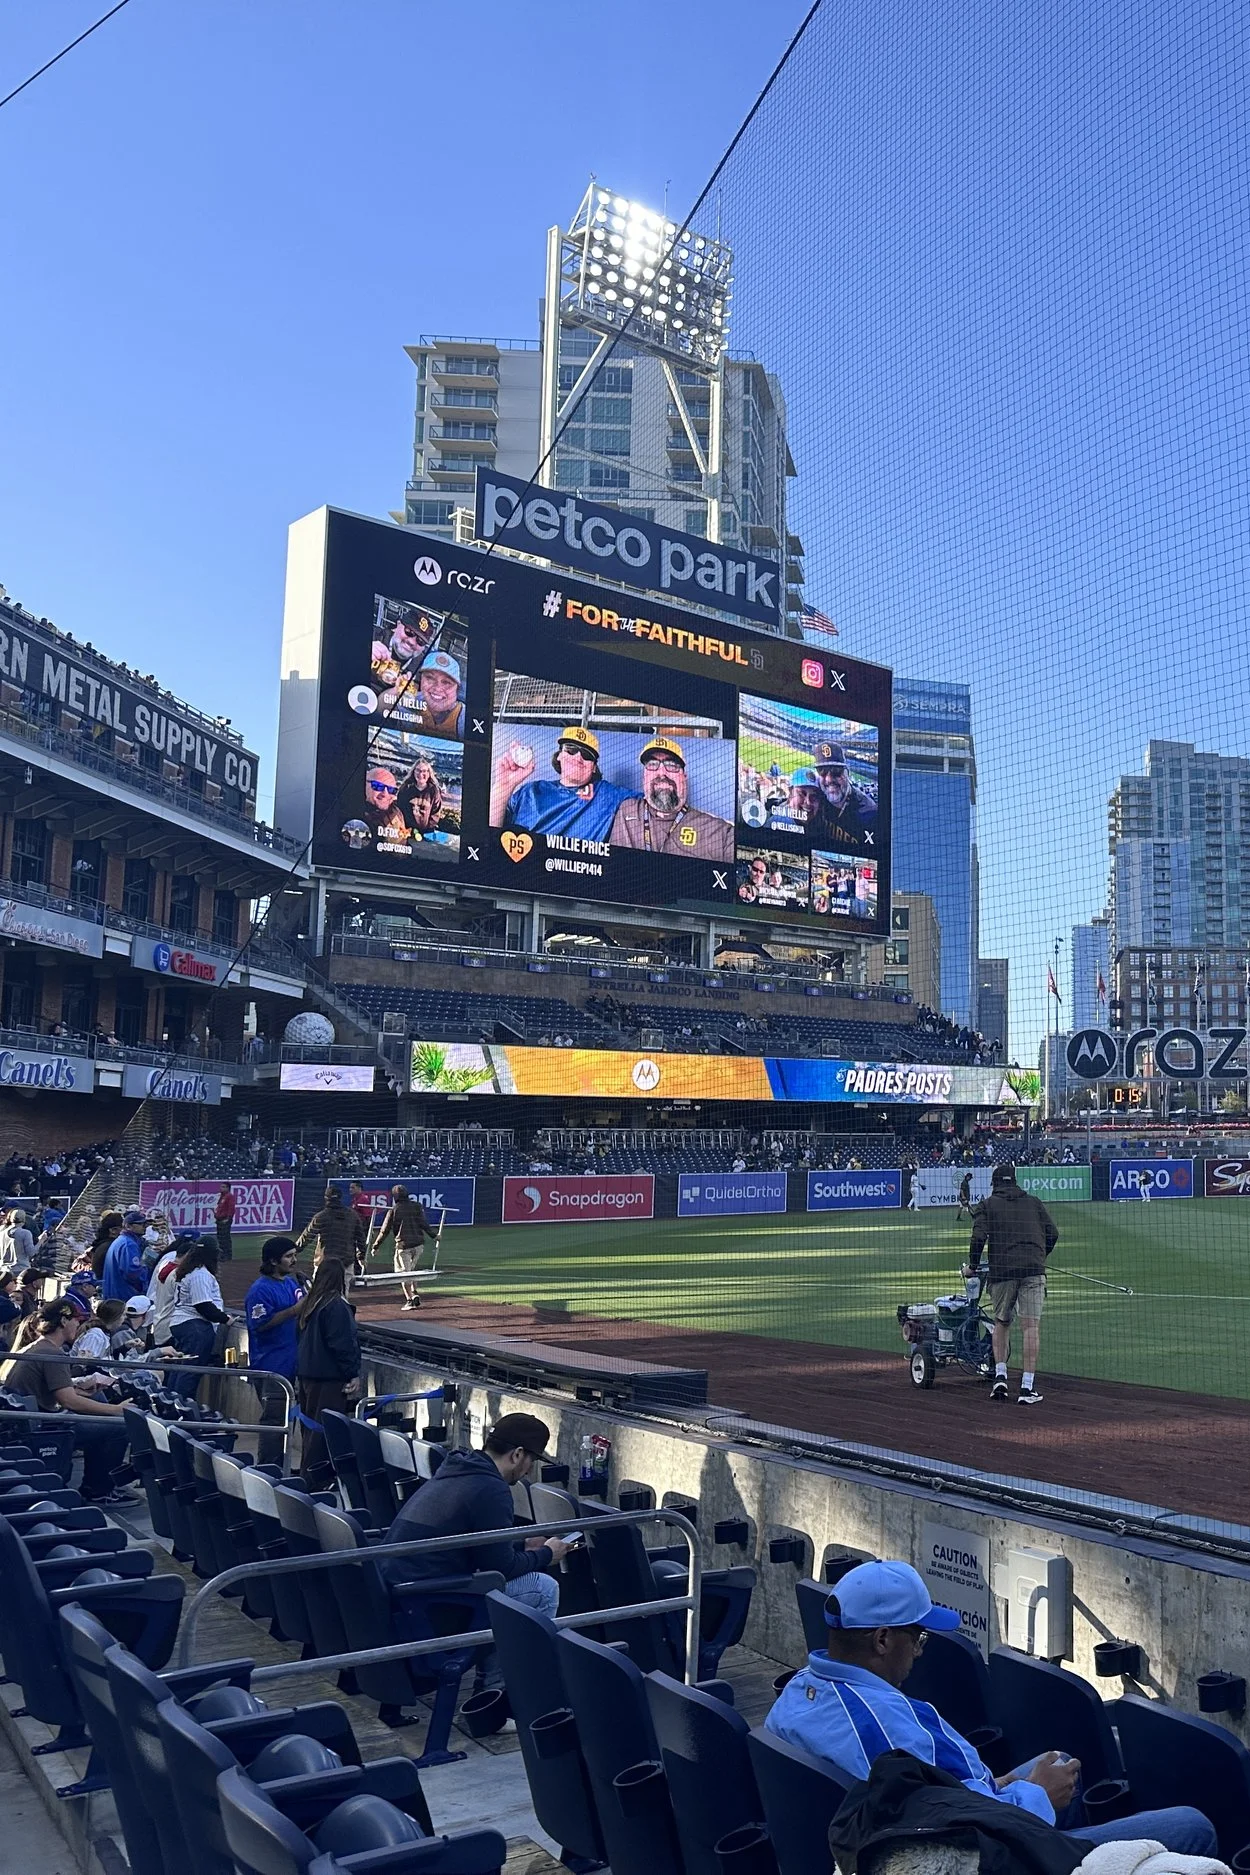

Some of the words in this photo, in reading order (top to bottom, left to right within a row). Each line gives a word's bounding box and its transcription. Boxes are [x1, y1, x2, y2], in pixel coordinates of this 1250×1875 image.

[482, 482, 652, 568] petco
[659, 537, 776, 609] park
[447, 570, 496, 594] razr
[635, 619, 749, 667] FAITHFUL
[911, 699, 966, 714] SEMPRA
[42, 653, 127, 734] METAL
[135, 703, 218, 777] SUPPLY
[224, 750, 256, 797] CO.
[545, 833, 581, 853] WILLIE
[581, 839, 611, 857] PRICE
[588, 979, 646, 993] ESTRELLA
[694, 988, 740, 1001] LANDING
[0, 1051, 76, 1089] Canel's
[843, 1068, 905, 1094] PADRES
[905, 1072, 953, 1095] POSTS
[148, 1069, 210, 1102] Canel's
[813, 1180, 887, 1198] Southwest
[1112, 1168, 1170, 1190] ARCO
[154, 1188, 218, 1207] Welcome
[230, 1183, 288, 1207] BAJA
[392, 1189, 445, 1208] ank
[548, 1190, 645, 1207] Snapdragon
[704, 1185, 783, 1202] QuidelOrtho
[146, 1205, 289, 1228] ALIFRNIA
[932, 1544, 978, 1570] CAUTION
